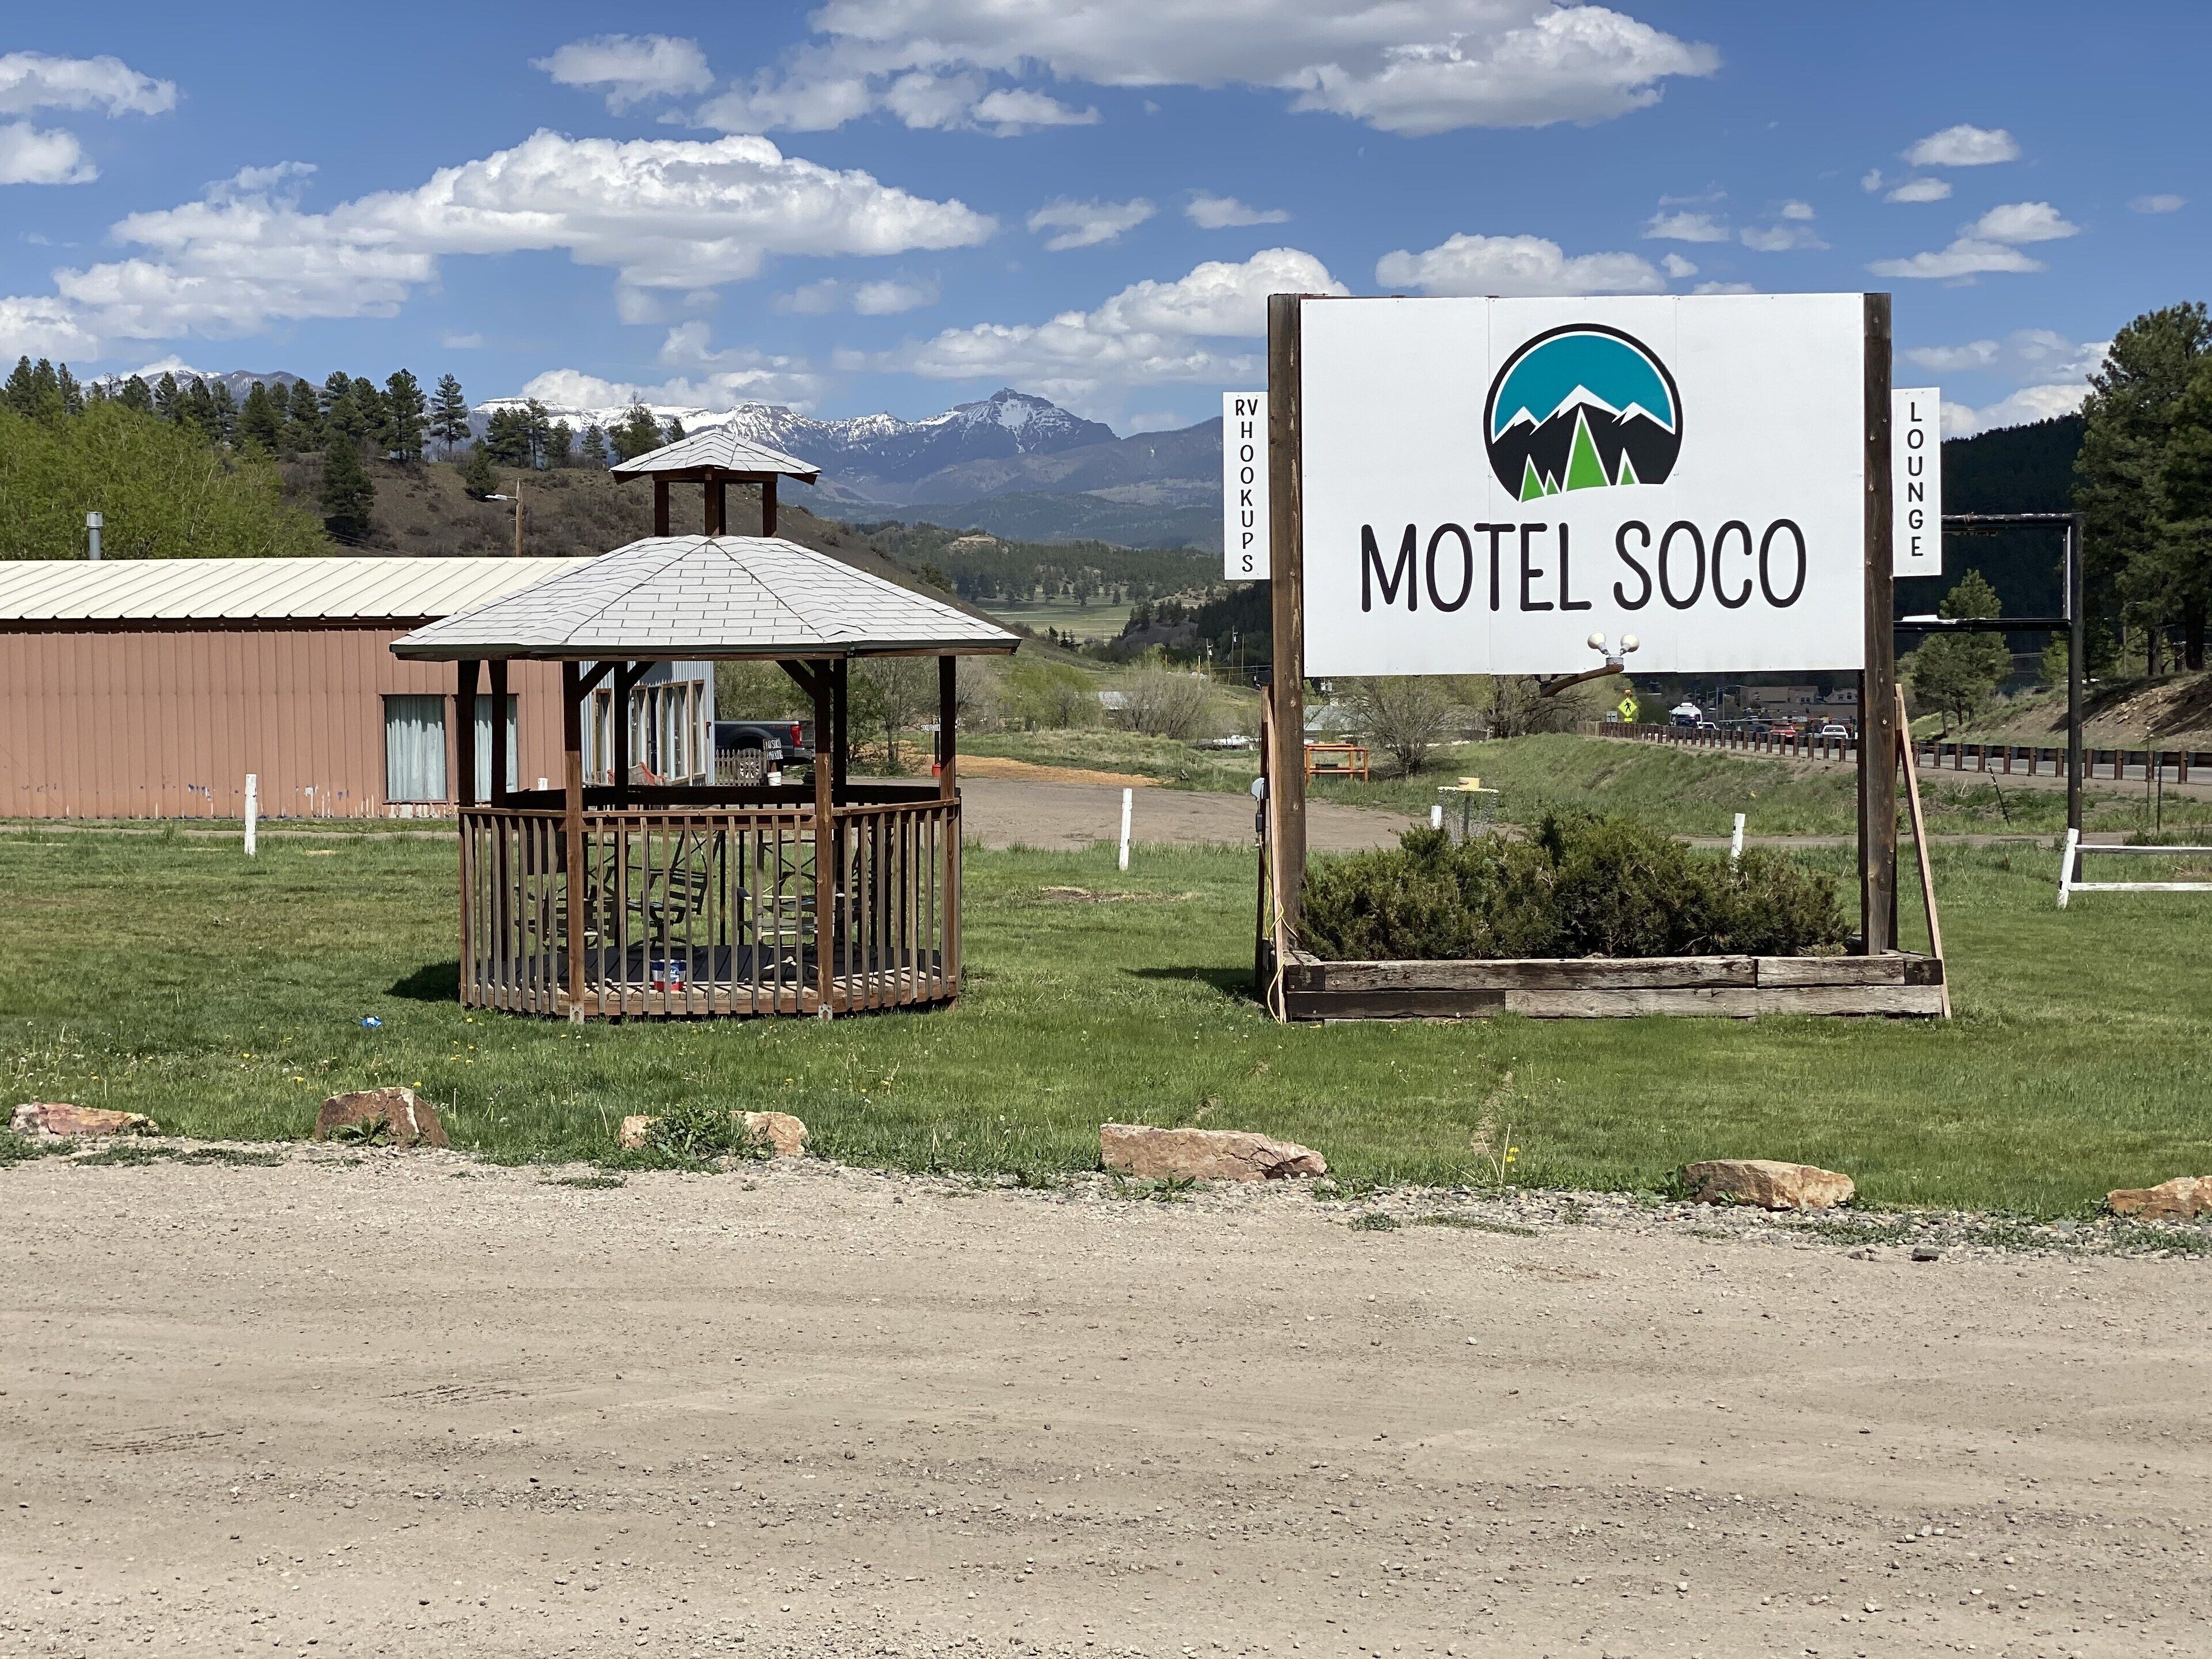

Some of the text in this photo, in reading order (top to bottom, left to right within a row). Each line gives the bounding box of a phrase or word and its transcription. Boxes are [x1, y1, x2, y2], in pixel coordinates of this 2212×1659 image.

[1235, 399, 1258, 416] RV
[1240, 421, 1254, 573] HOOKUPS
[1907, 402, 1924, 557] LOUNGE
[1361, 518, 1806, 612] MOTEL SOCO
